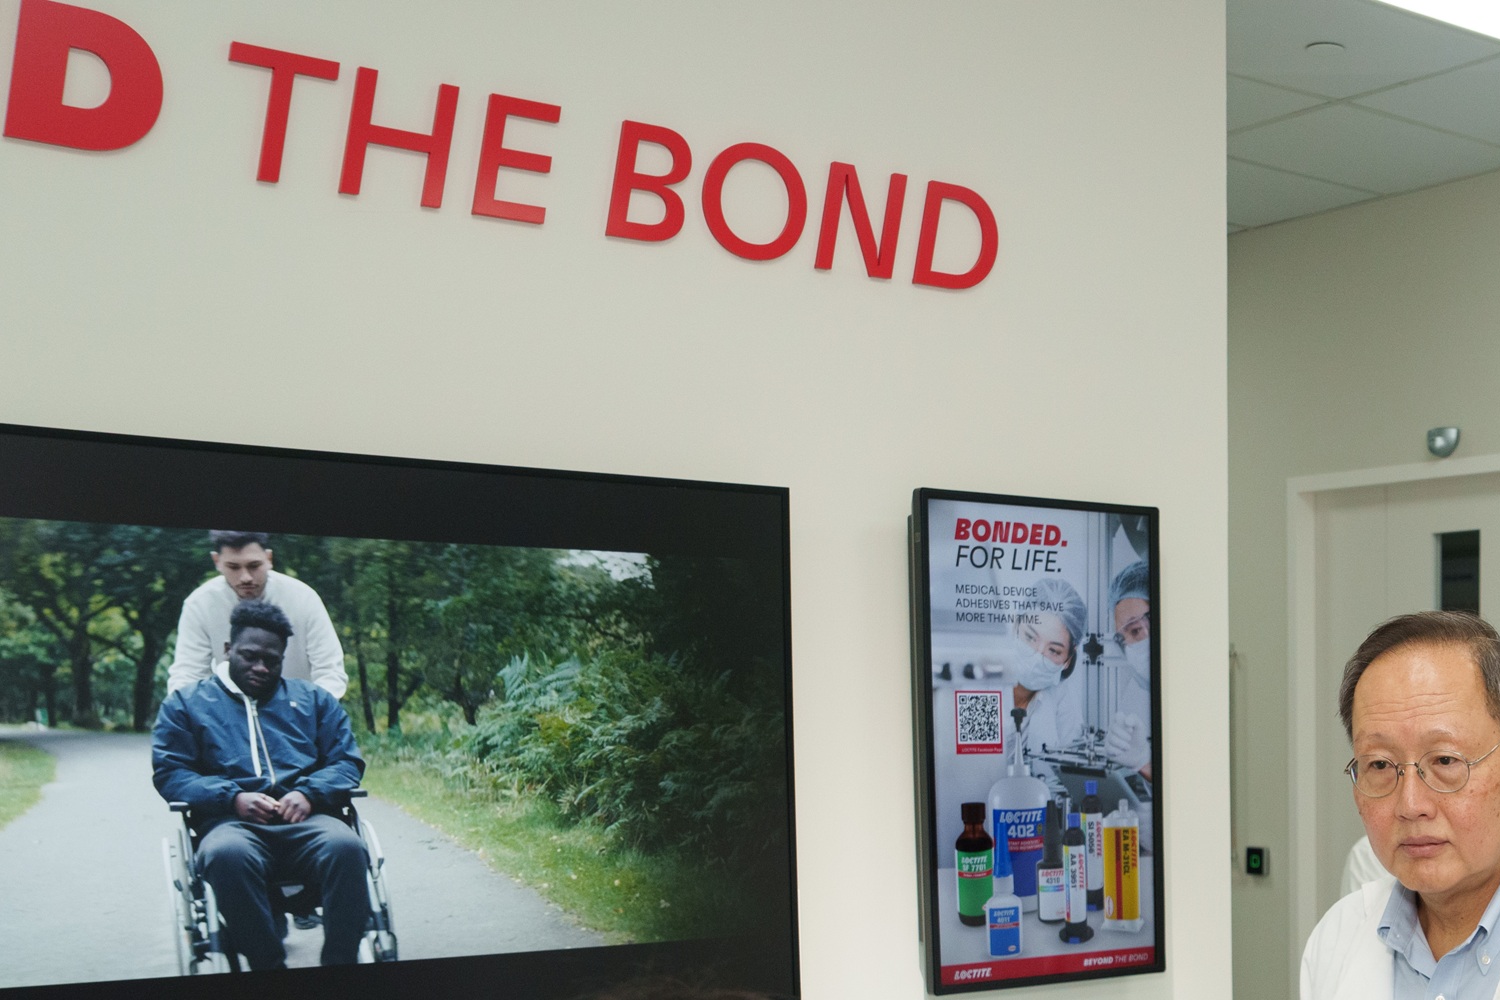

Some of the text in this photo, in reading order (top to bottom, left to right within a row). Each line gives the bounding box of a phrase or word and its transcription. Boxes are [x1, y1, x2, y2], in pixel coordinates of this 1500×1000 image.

[228, 41, 562, 224] THE
[605, 119, 1000, 291] BOND
[954, 517, 1068, 548] BONDED.
[955, 544, 1062, 573] FOR LIFE.
[955, 584, 1038, 598] MEDICAL DEVICE
[955, 598, 1065, 612] ADHESIVES THAT SAVE
[956, 612, 1042, 625] MORE THAN TIME.
[1000, 809, 1043, 824] LOCTITE
[1007, 823, 1035, 838] 402
[1083, 953, 1149, 967] BEYOND THE BOND
[954, 967, 992, 981] LOCTITE
